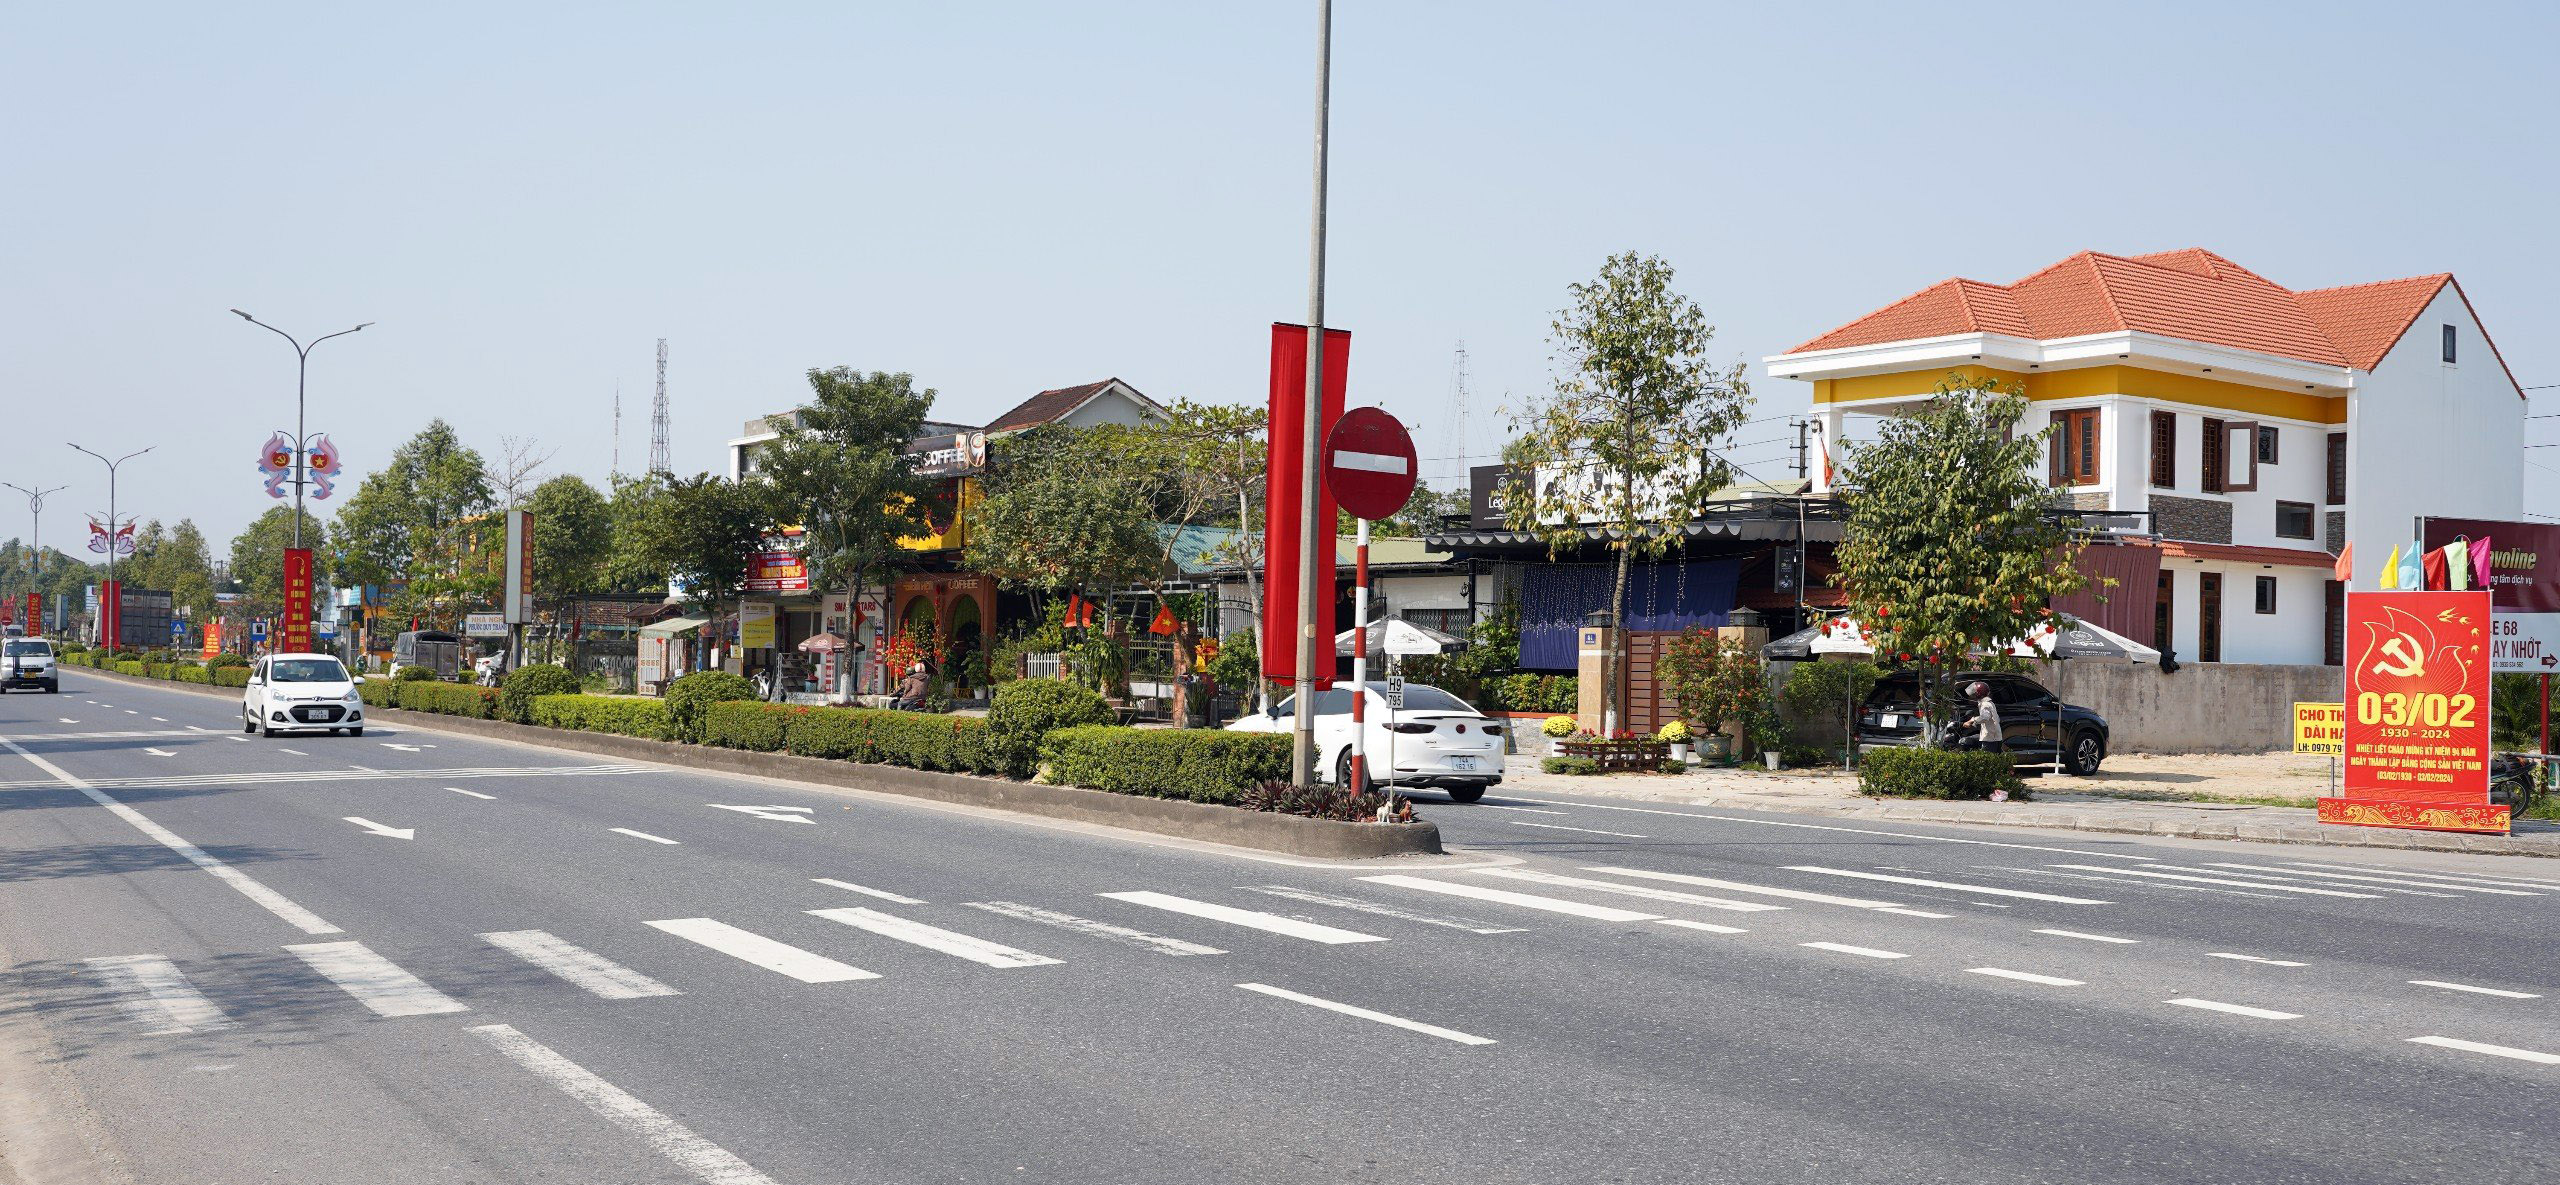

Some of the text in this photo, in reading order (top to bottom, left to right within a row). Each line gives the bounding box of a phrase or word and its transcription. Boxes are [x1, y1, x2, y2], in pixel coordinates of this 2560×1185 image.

[2511, 574, 2524, 586] dịch
[2525, 577, 2533, 586] vụ
[2503, 620, 2518, 636] 68
[2511, 636, 2541, 659] NHỚT
[1389, 678, 1402, 692] H9
[1389, 695, 1402, 706] 795
[2299, 709, 2344, 721] CHO TH
[2357, 691, 2476, 728] 03/02
[2304, 725, 2344, 742] DÀI HẠ
[2380, 728, 2409, 738] 1930
[2421, 729, 2451, 739] 2024
[2298, 743, 2344, 753] LH: 0979 79
[2356, 743, 2373, 754] NHIỆT
[2374, 743, 2387, 755] LIỆT
[2388, 743, 2404, 755] CHÀO
[2405, 744, 2424, 756] MỪNG
[2434, 745, 2451, 757] NIỆM
[2452, 747, 2460, 756] 94
[2461, 746, 2477, 757] NĂM
[2350, 756, 2367, 766] NGÀY
[2368, 756, 2388, 767] THÀNH
[2389, 757, 2400, 769] LẬP
[2401, 757, 2418, 768] ĐẢNG
[2419, 759, 2437, 770] CỘNG
[2452, 758, 2465, 772] VIỆT
[2466, 761, 2482, 770] NAM
